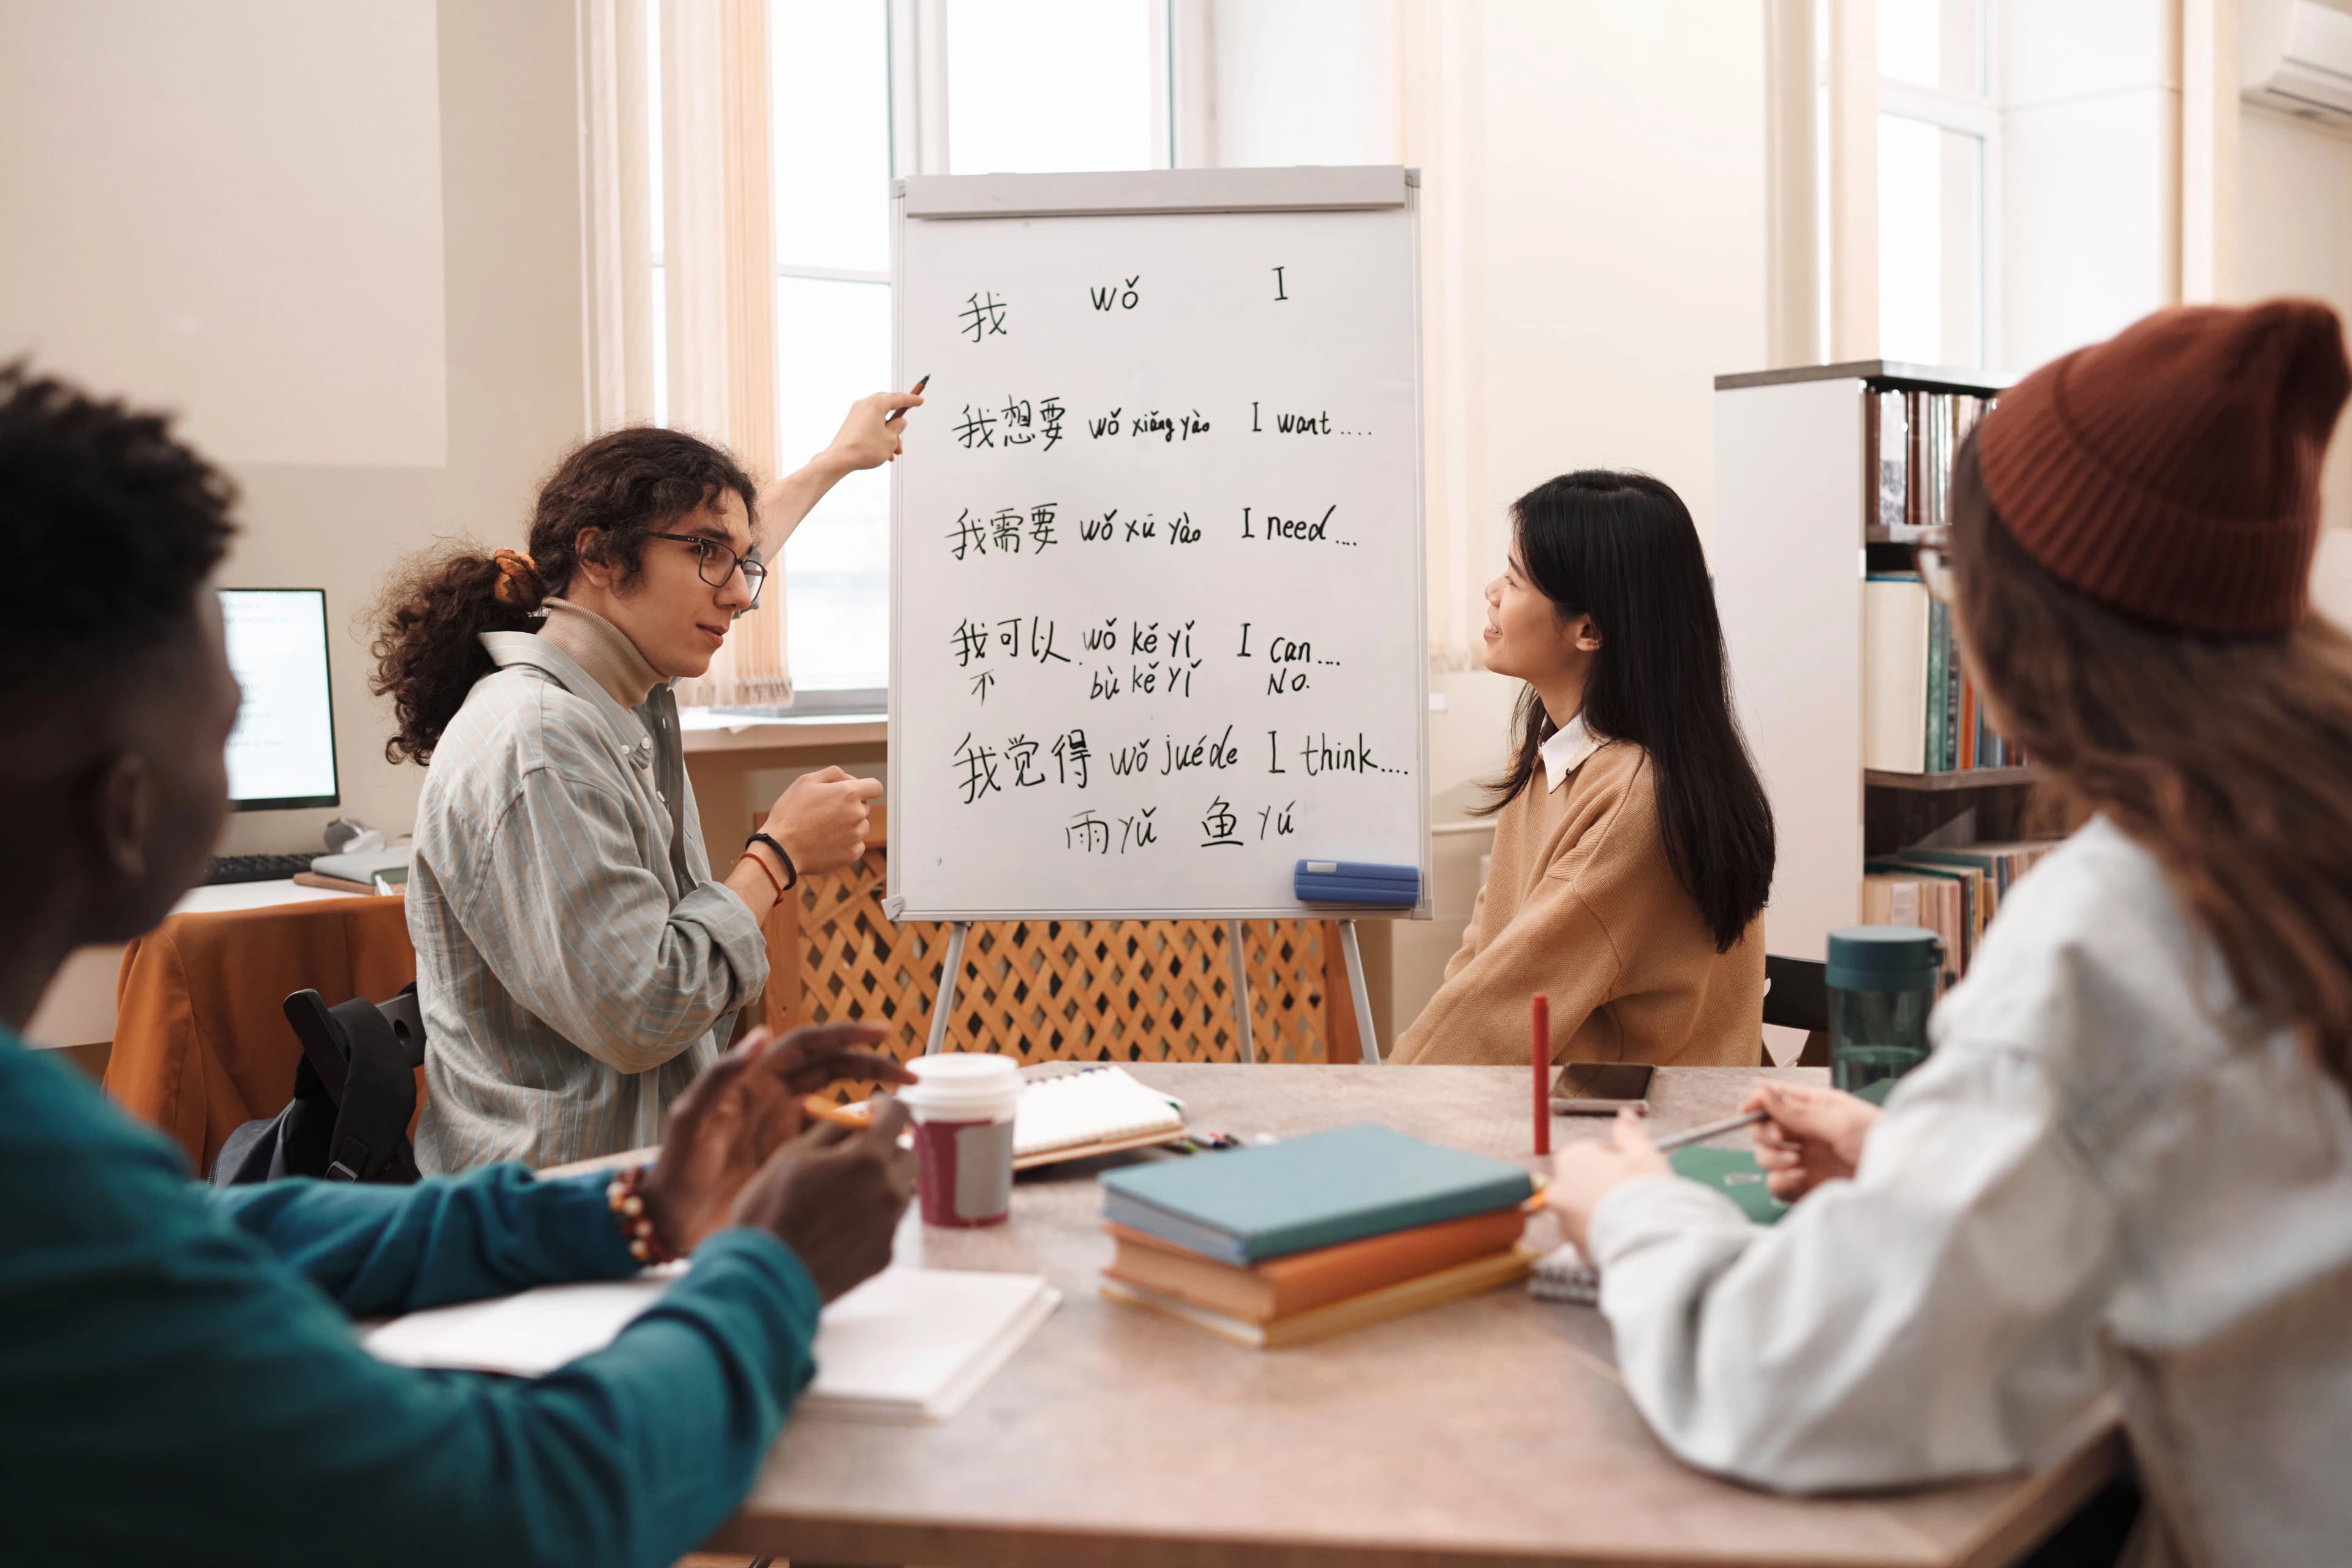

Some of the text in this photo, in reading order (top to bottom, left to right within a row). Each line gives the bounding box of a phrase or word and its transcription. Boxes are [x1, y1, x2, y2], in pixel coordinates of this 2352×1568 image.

[1272, 266, 1289, 301] I
[958, 291, 1008, 343] 我
[951, 394, 1066, 452] 我想要
[1251, 401, 1262, 432] I
[944, 502, 1058, 561] 我需要
[1241, 507, 1256, 539] I
[1236, 622, 1252, 658] I
[970, 669, 995, 706] 不
[952, 728, 1092, 805] 我觉得
[1267, 730, 1286, 774] I
[1065, 809, 1109, 855] 雨
[1200, 795, 1245, 848] 鱼
